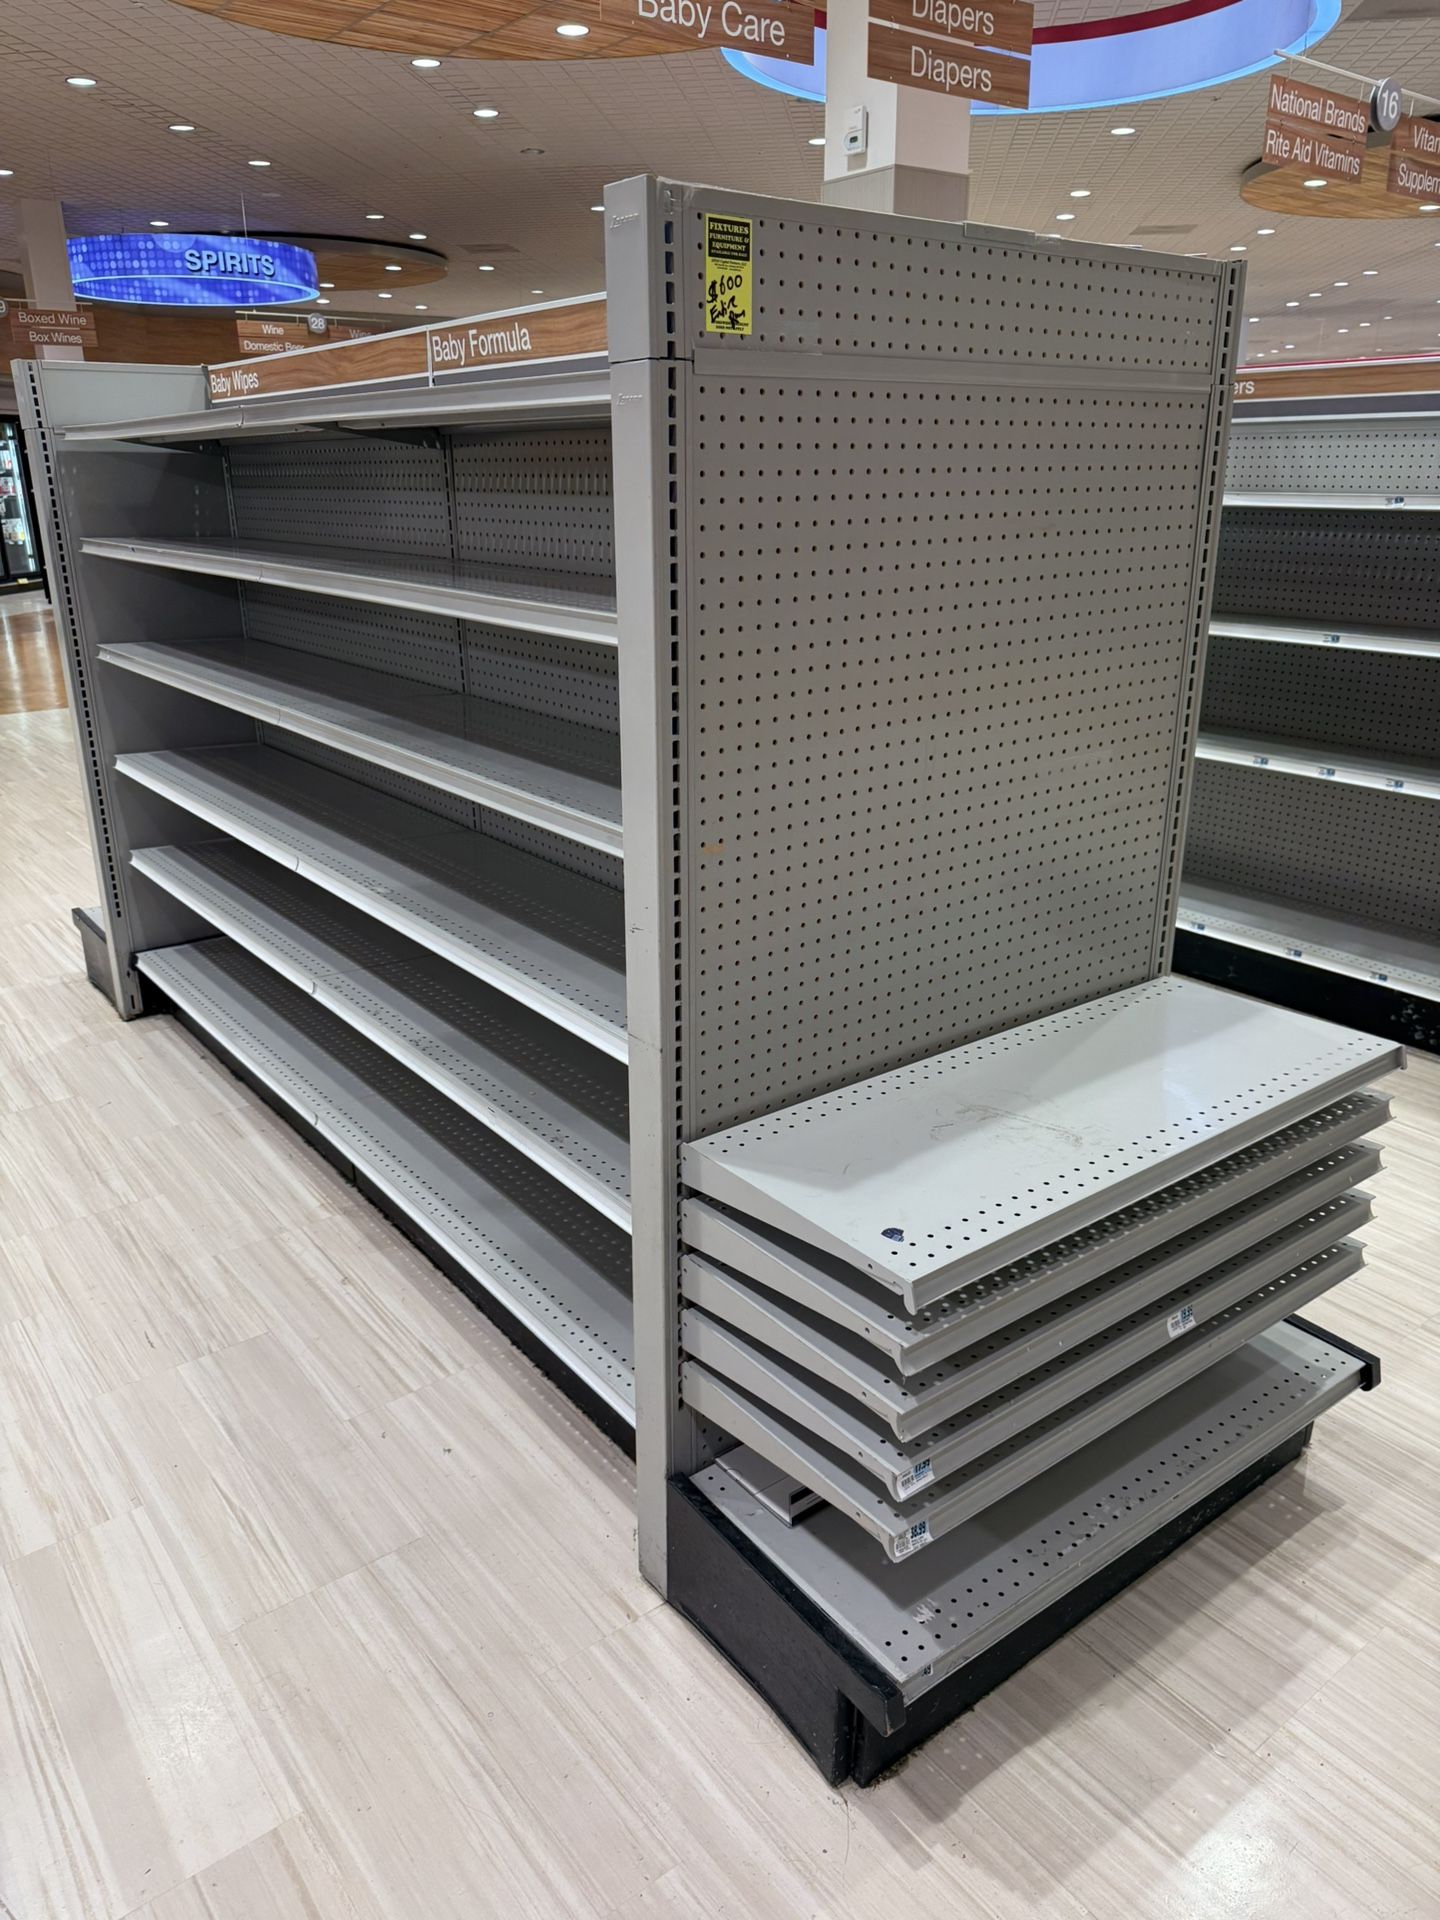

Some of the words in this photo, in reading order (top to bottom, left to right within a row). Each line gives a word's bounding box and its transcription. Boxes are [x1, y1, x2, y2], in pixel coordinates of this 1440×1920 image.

[638, 0, 712, 38] Baby
[721, 1, 785, 46] Care
[912, 0, 994, 35] Diapers
[911, 45, 992, 92] Diapers
[1270, 84, 1323, 120] National
[1324, 100, 1366, 134] Brands
[1381, 91, 1398, 119] 16
[1266, 130, 1290, 158] Rite
[1291, 137, 1312, 163] Aid
[1314, 144, 1360, 176] Vitamins
[709, 222, 749, 234] FIXTURES
[709, 233, 743, 242] FURNITURE
[712, 241, 746, 251] EQUIPMENT
[184, 249, 275, 277] SPIRITS
[706, 274, 742, 303] $600
[18, 312, 55, 324] Boxed
[57, 313, 87, 325] Wine
[261, 324, 284, 335] Wine
[311, 318, 325, 329] 28
[29, 331, 50, 342] Box
[50, 332, 83, 344] Wines
[243, 340, 284, 352] Domestic
[432, 333, 466, 366] Baby
[468, 322, 532, 358] Formula
[210, 373, 231, 396] Baby
[232, 370, 259, 394] Wipes
